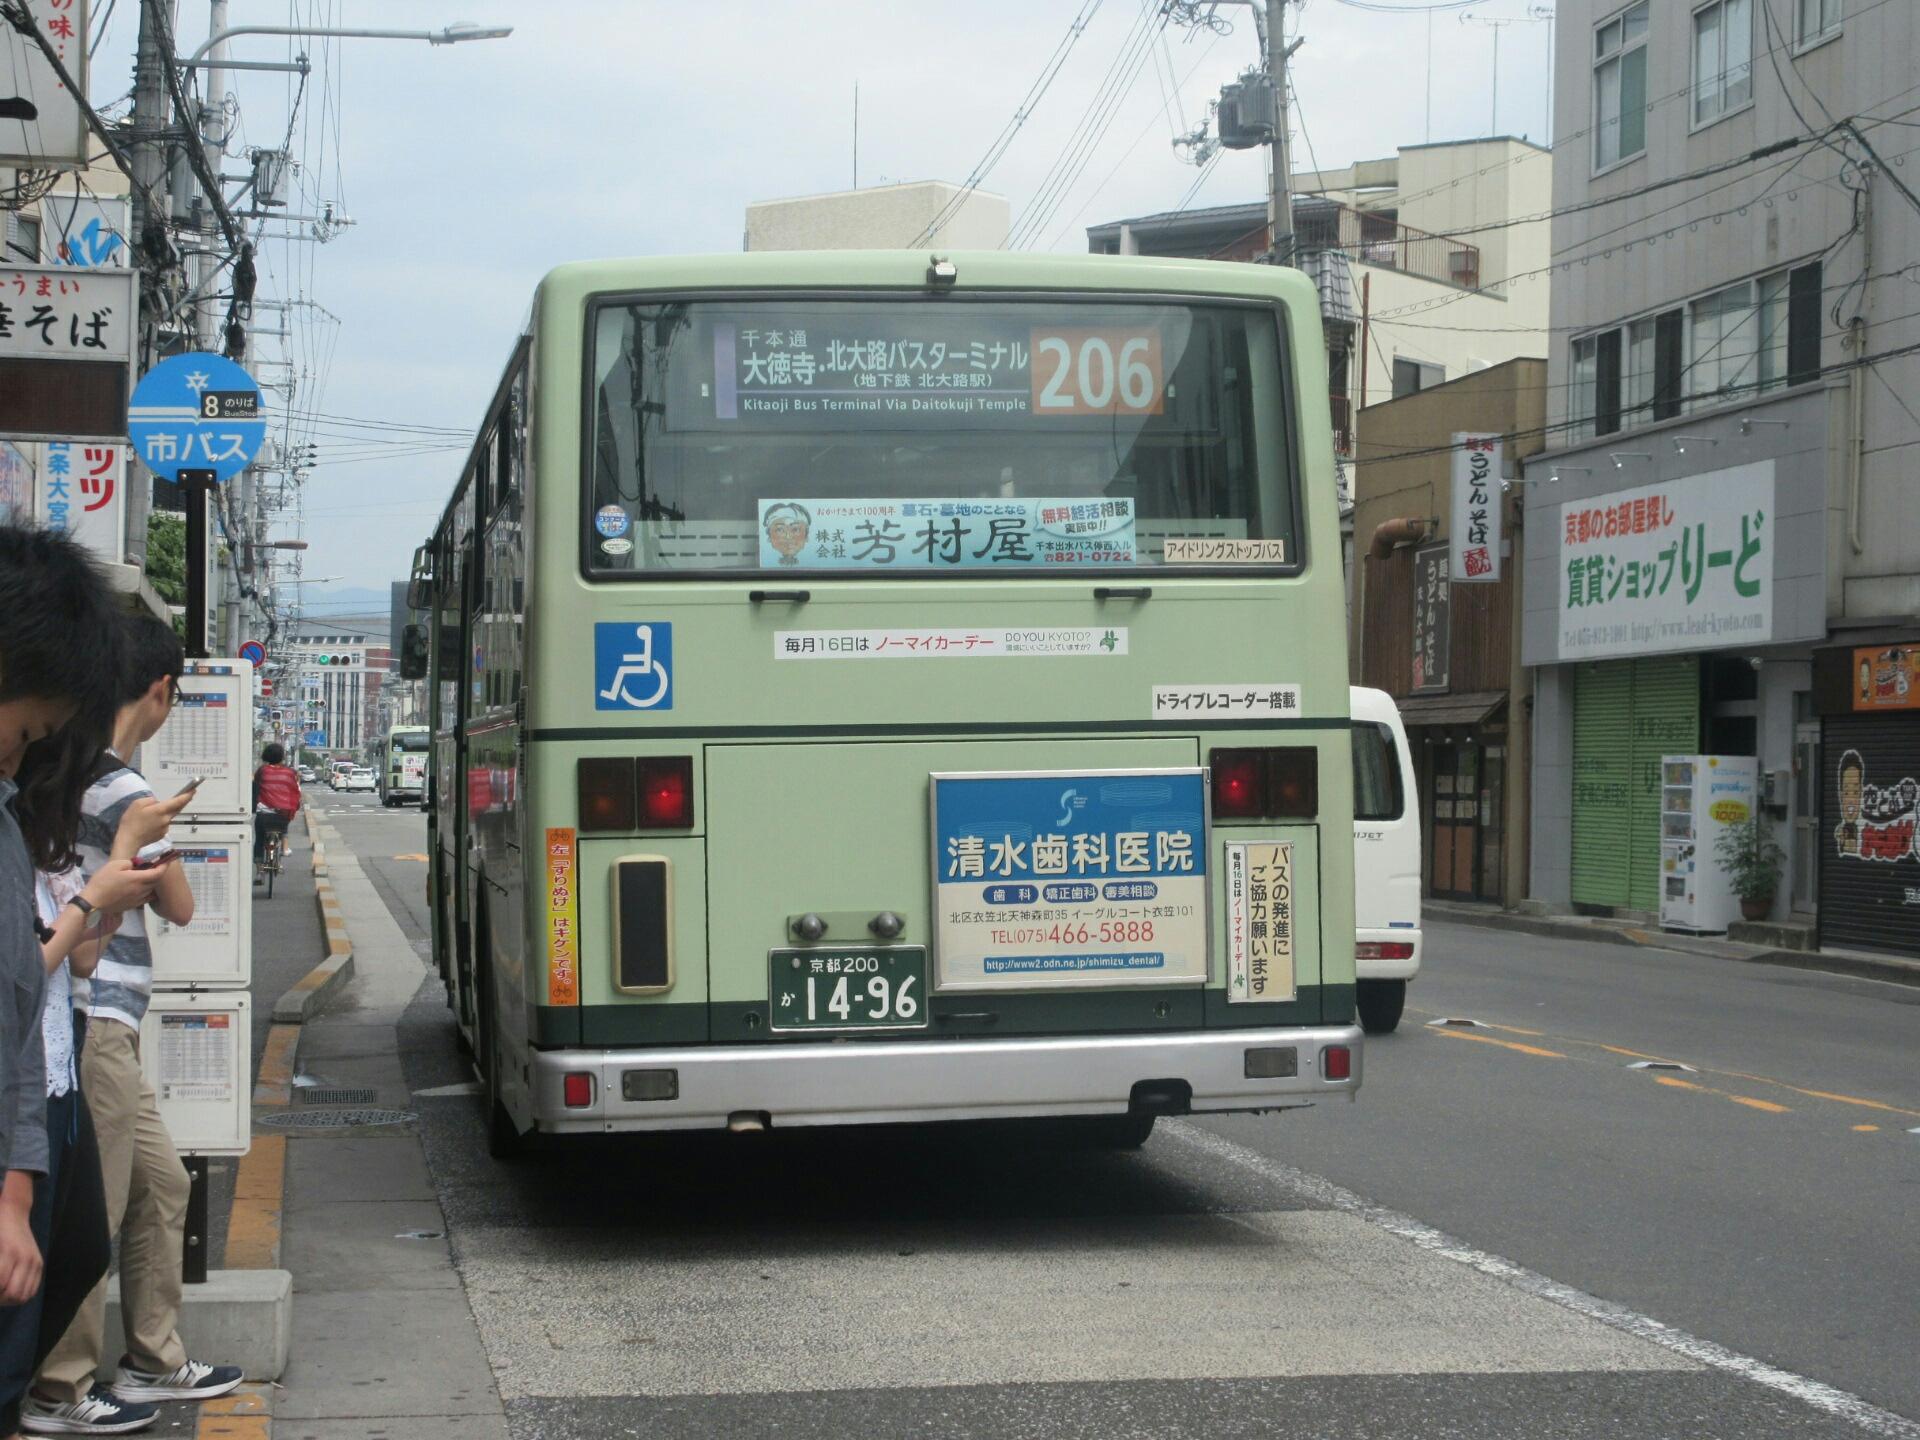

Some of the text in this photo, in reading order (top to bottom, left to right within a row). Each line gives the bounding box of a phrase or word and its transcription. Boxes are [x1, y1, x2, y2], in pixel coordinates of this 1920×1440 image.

[0, 273, 80, 297] うまい
[741, 329, 808, 348] 千本通
[853, 372, 992, 388] (地下鉄 北大路駅)
[1039, 337, 1153, 408] 206
[205, 395, 255, 417] 8 のりば
[743, 399, 1026, 413] Kitaoji Bus Terminal Via Daitokuji Temple
[145, 432, 249, 462] 市バス
[1468, 453, 1491, 544] うどん そば
[1041, 500, 1130, 525] 無料終活相談
[1565, 495, 1674, 546] 京都のお部屋探し
[816, 528, 845, 543] 株式
[852, 517, 1034, 564] 芳村屋
[816, 546, 846, 558] 会社
[1166, 542, 1282, 559] アイドリングストップバス
[785, 635, 994, 653] 毎月16日は ノーマイカーデー
[1006, 632, 1091, 641] DO YOU KYOTO?
[1156, 691, 1296, 710] ドライブレコーダー搭載
[947, 830, 1194, 877] 清水歯科医院
[993, 888, 1031, 902] 歯科
[1272, 847, 1290, 956] バスの発進に
[1250, 865, 1268, 994] ご協力願います
[781, 975, 917, 1020] か 14-96
